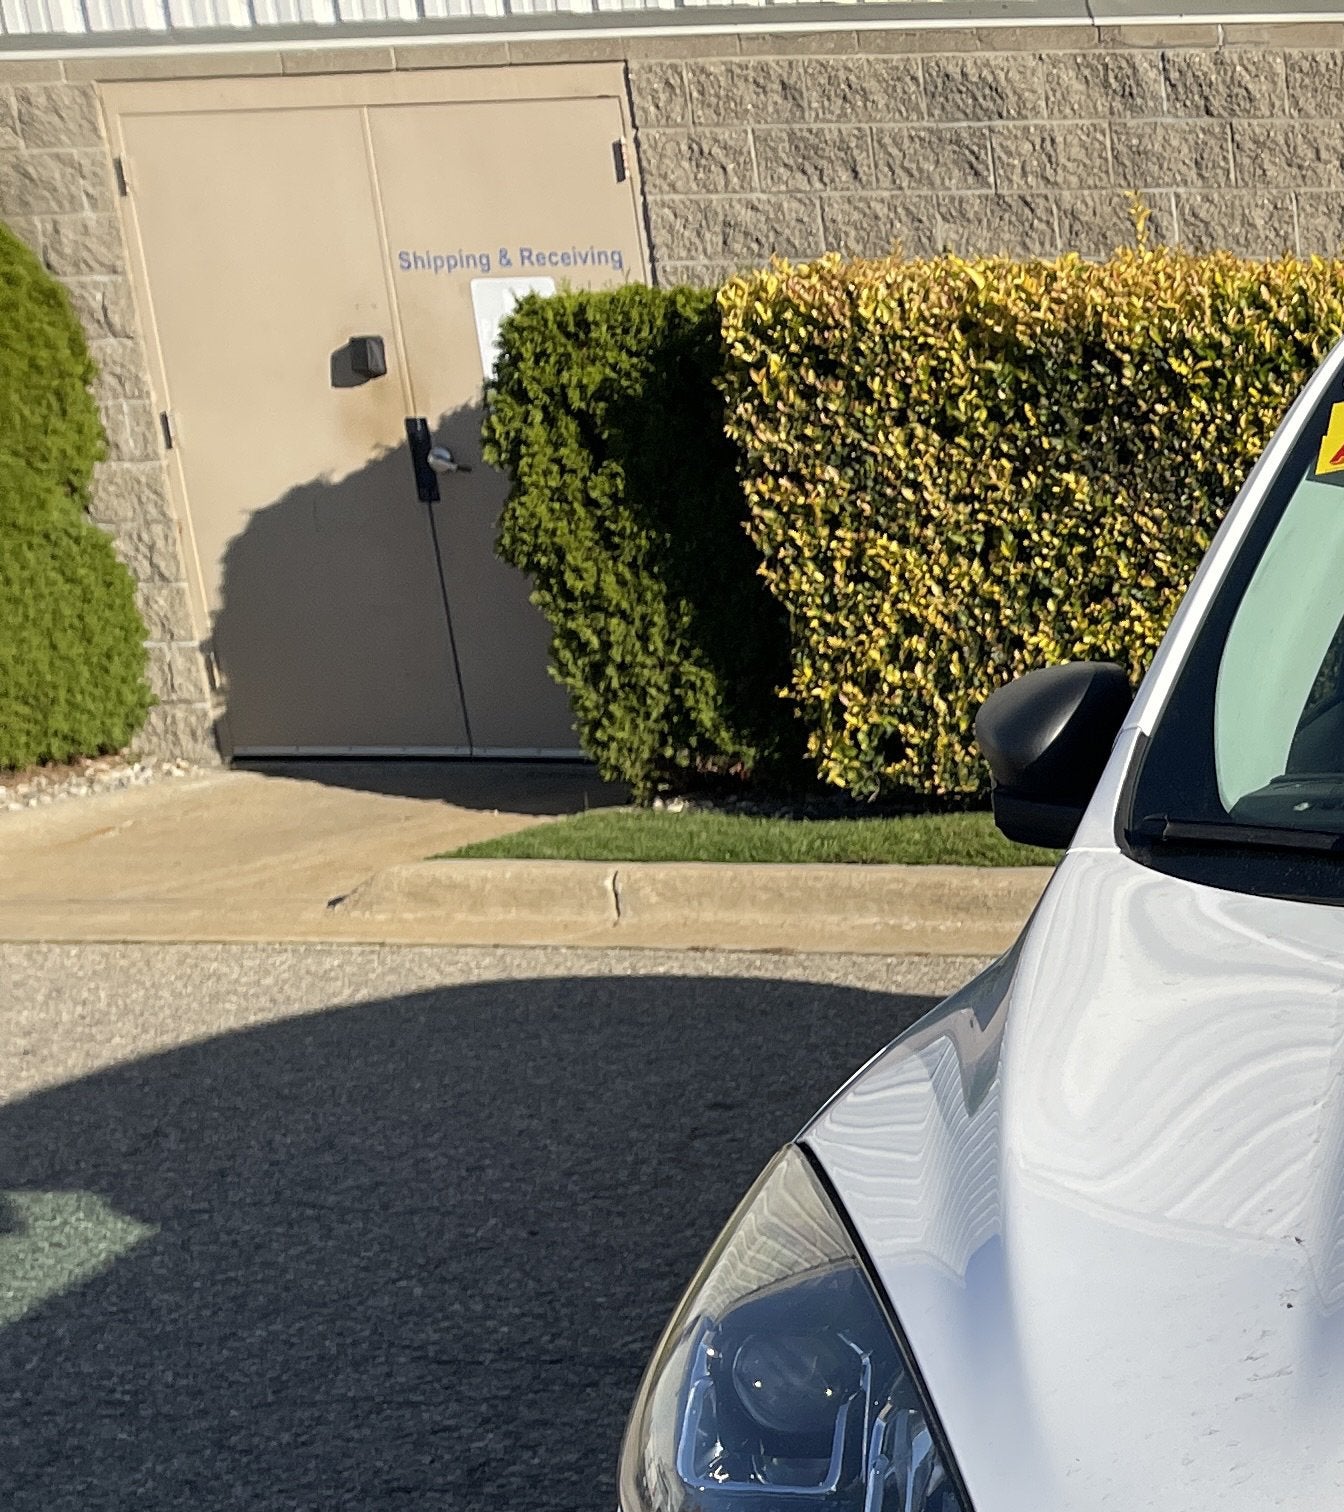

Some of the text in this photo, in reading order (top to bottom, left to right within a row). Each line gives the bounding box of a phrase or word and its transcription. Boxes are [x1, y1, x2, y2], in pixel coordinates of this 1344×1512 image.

[398, 246, 624, 274] Shipping & Receiving
